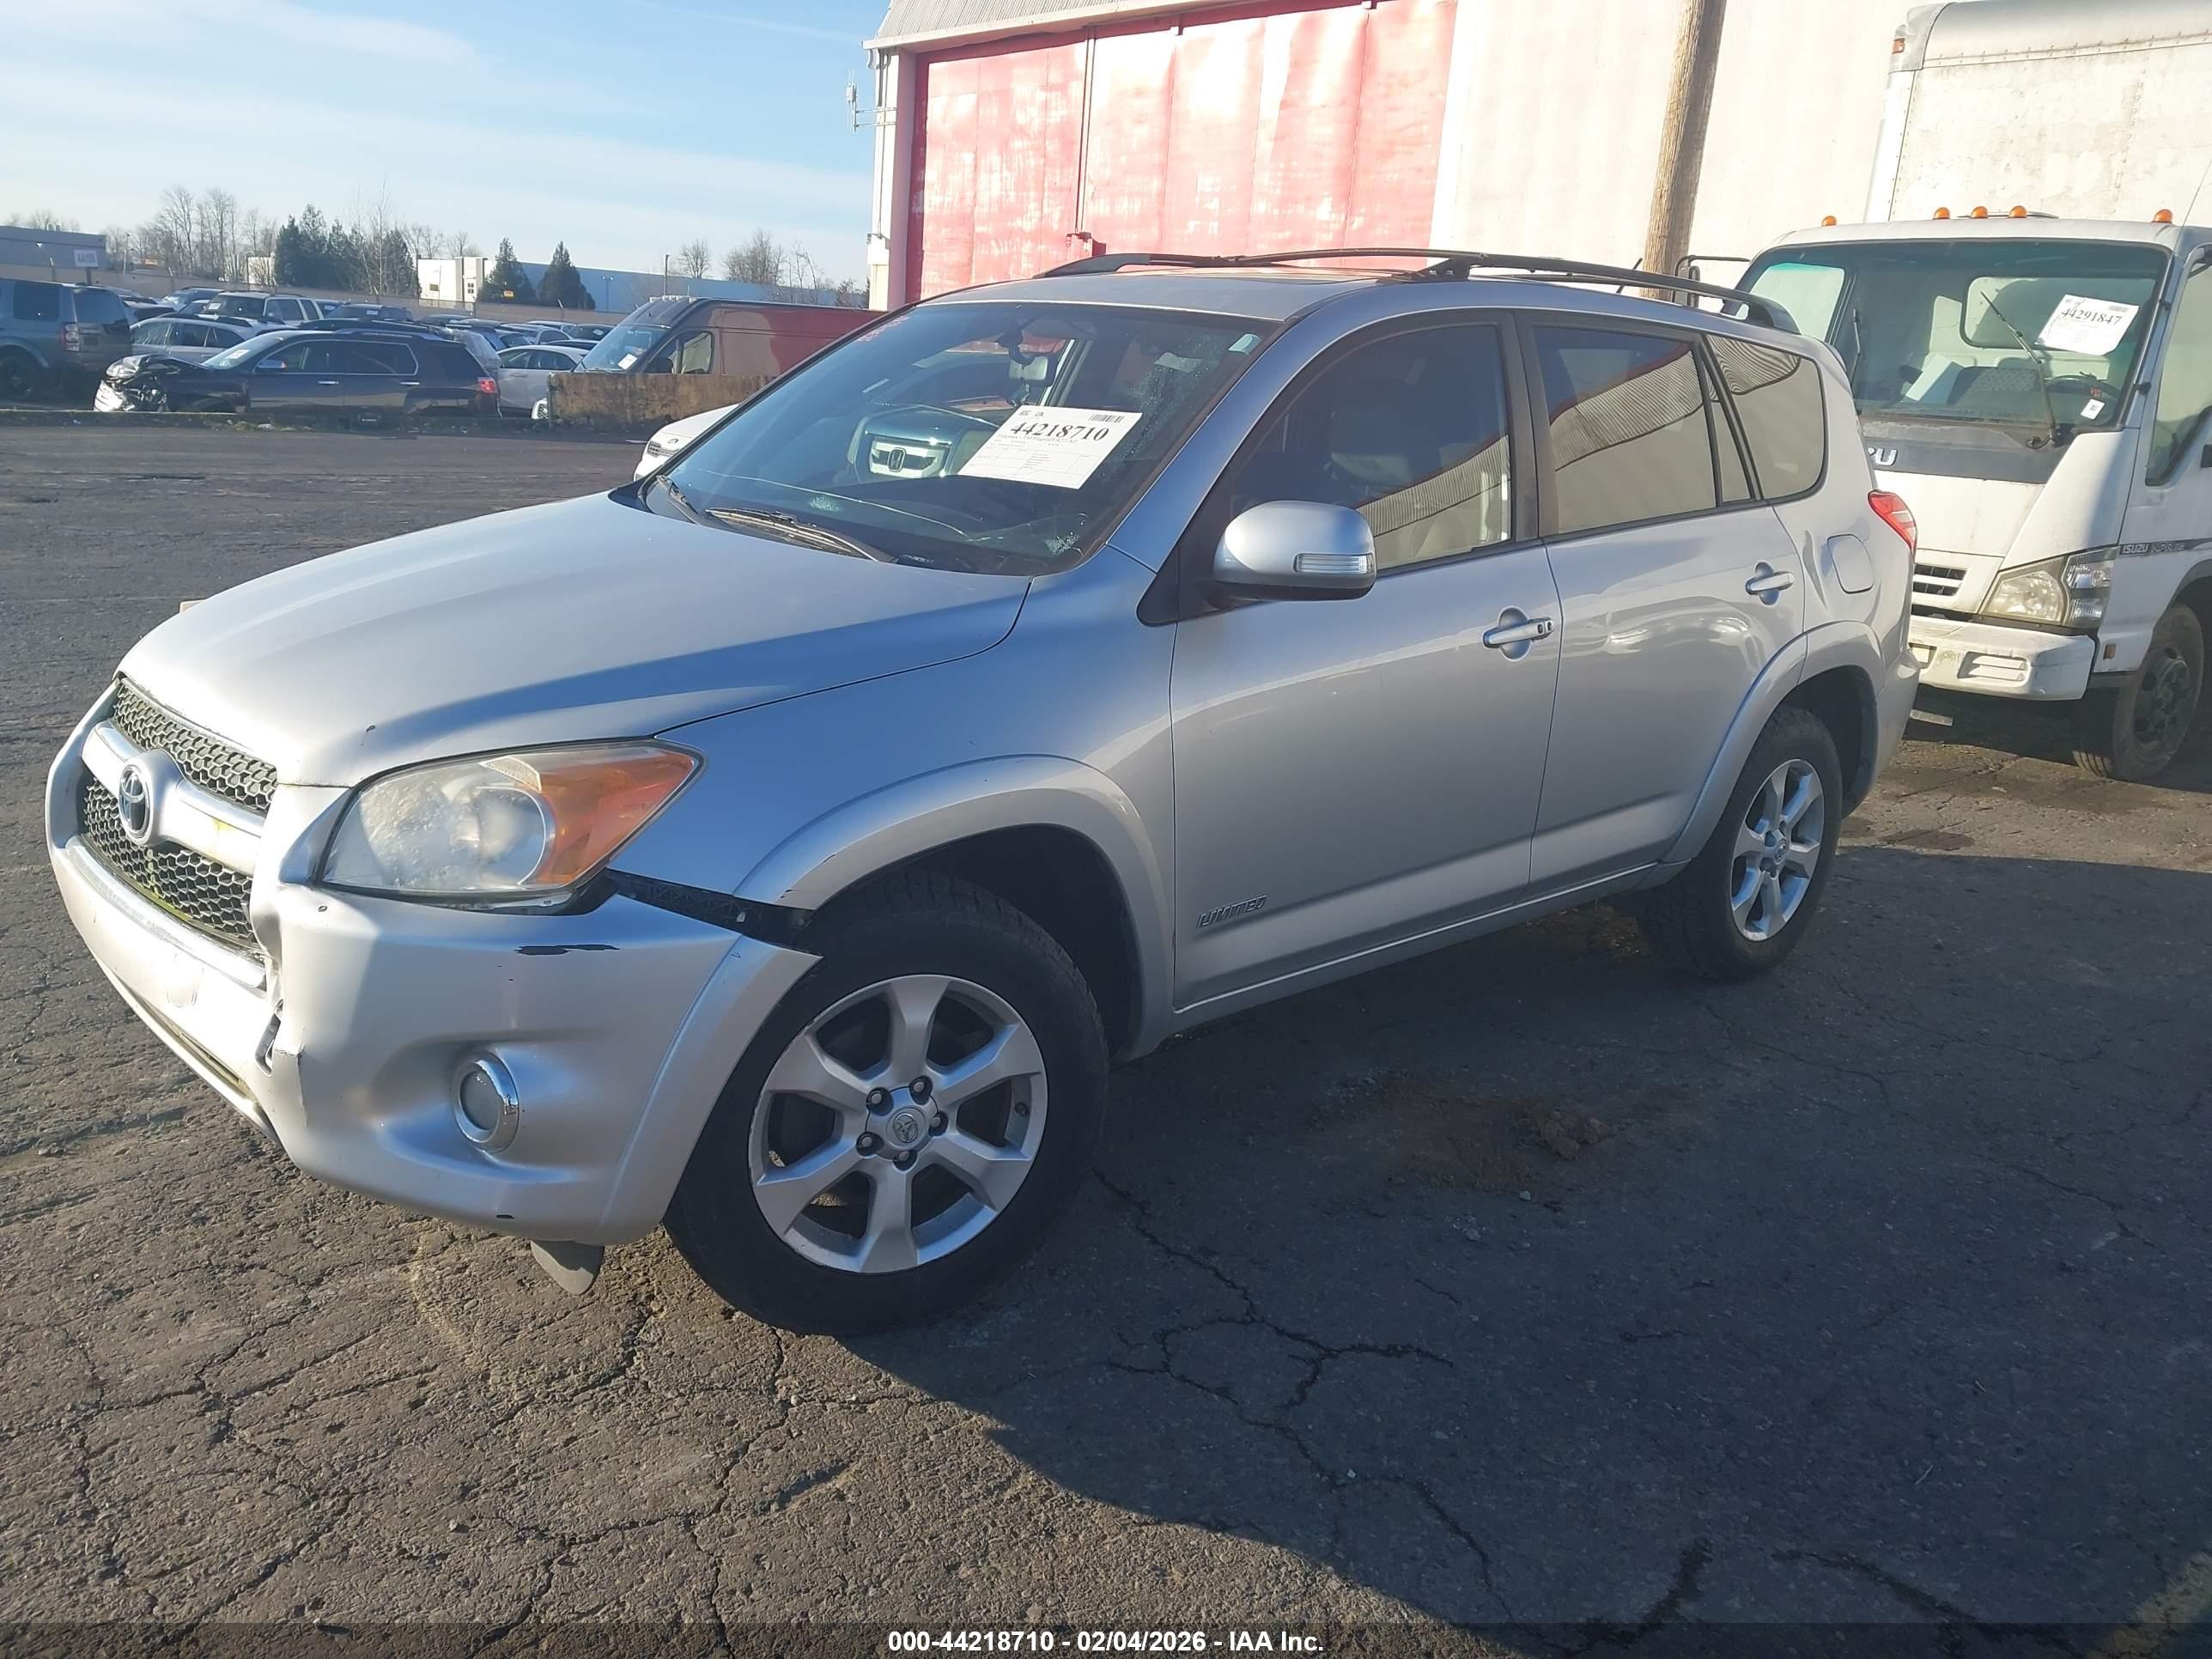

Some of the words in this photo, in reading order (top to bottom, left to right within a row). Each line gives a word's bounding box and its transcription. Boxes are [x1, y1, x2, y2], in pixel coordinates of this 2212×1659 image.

[2061, 308, 2123, 325] 44291847
[1010, 422, 1109, 441] 44218710
[2122, 543, 2149, 555] ISUZU
[1195, 894, 1268, 928] LIMITED
